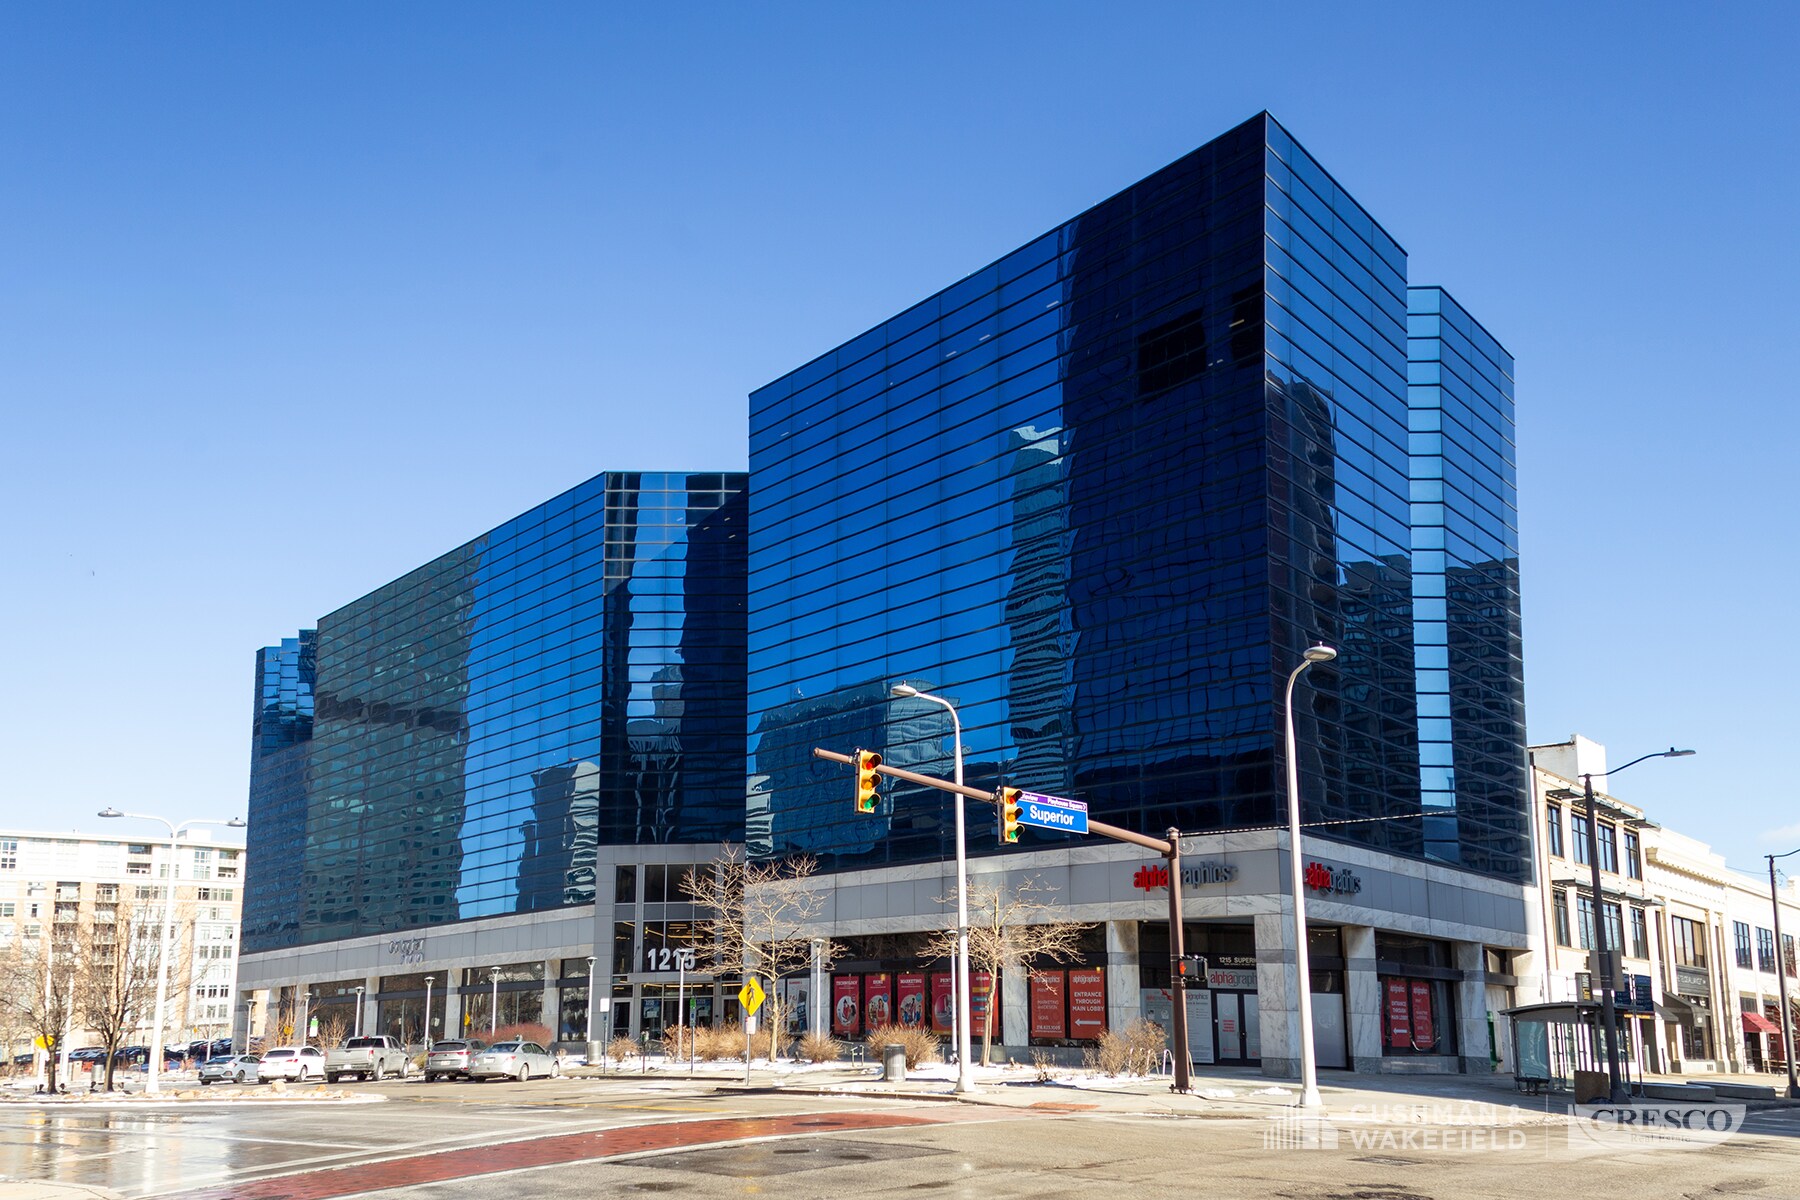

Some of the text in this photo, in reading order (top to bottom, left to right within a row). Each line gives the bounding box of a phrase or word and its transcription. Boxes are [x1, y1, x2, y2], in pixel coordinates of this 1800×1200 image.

[1029, 804, 1074, 825] Superior
[1133, 862, 1231, 892] alpharaphics
[647, 948, 696, 971] 1215
